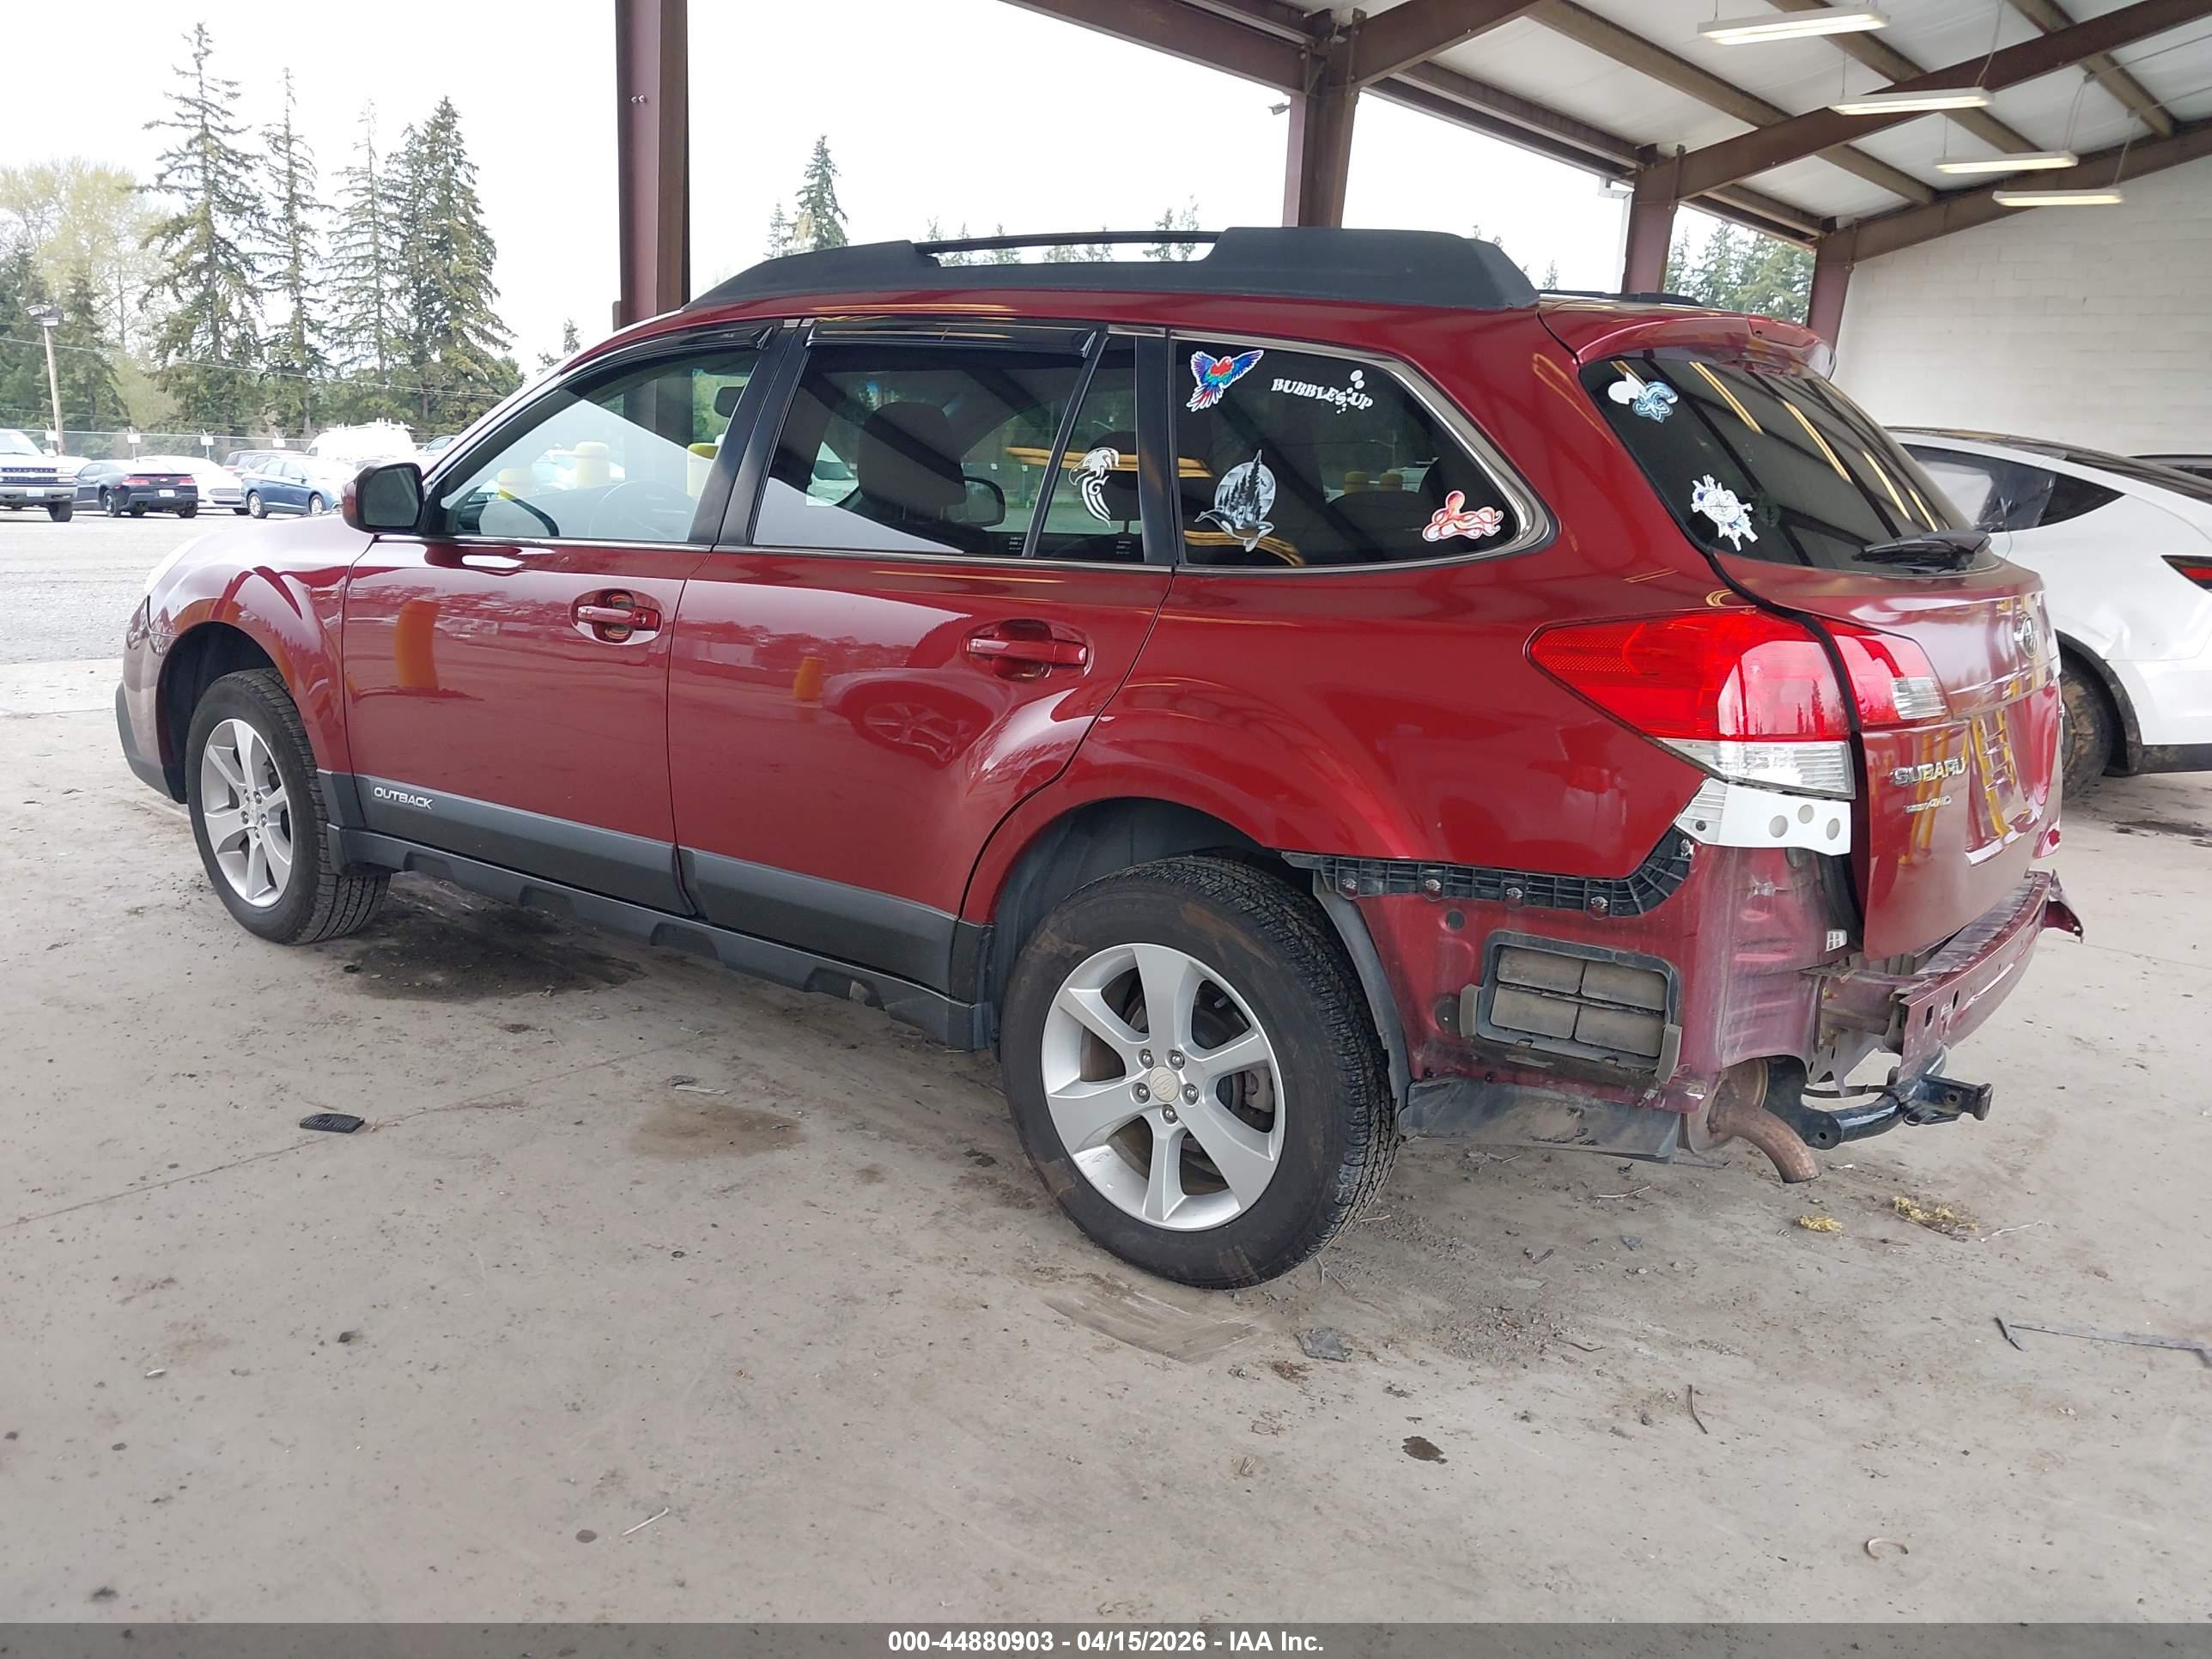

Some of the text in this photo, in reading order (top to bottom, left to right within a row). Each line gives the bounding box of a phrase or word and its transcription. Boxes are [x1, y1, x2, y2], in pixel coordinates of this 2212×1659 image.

[1271, 378, 1374, 410] BUBBLES UP
[1892, 757, 1966, 785] SUBARU
[374, 787, 434, 810] OUTBACK
